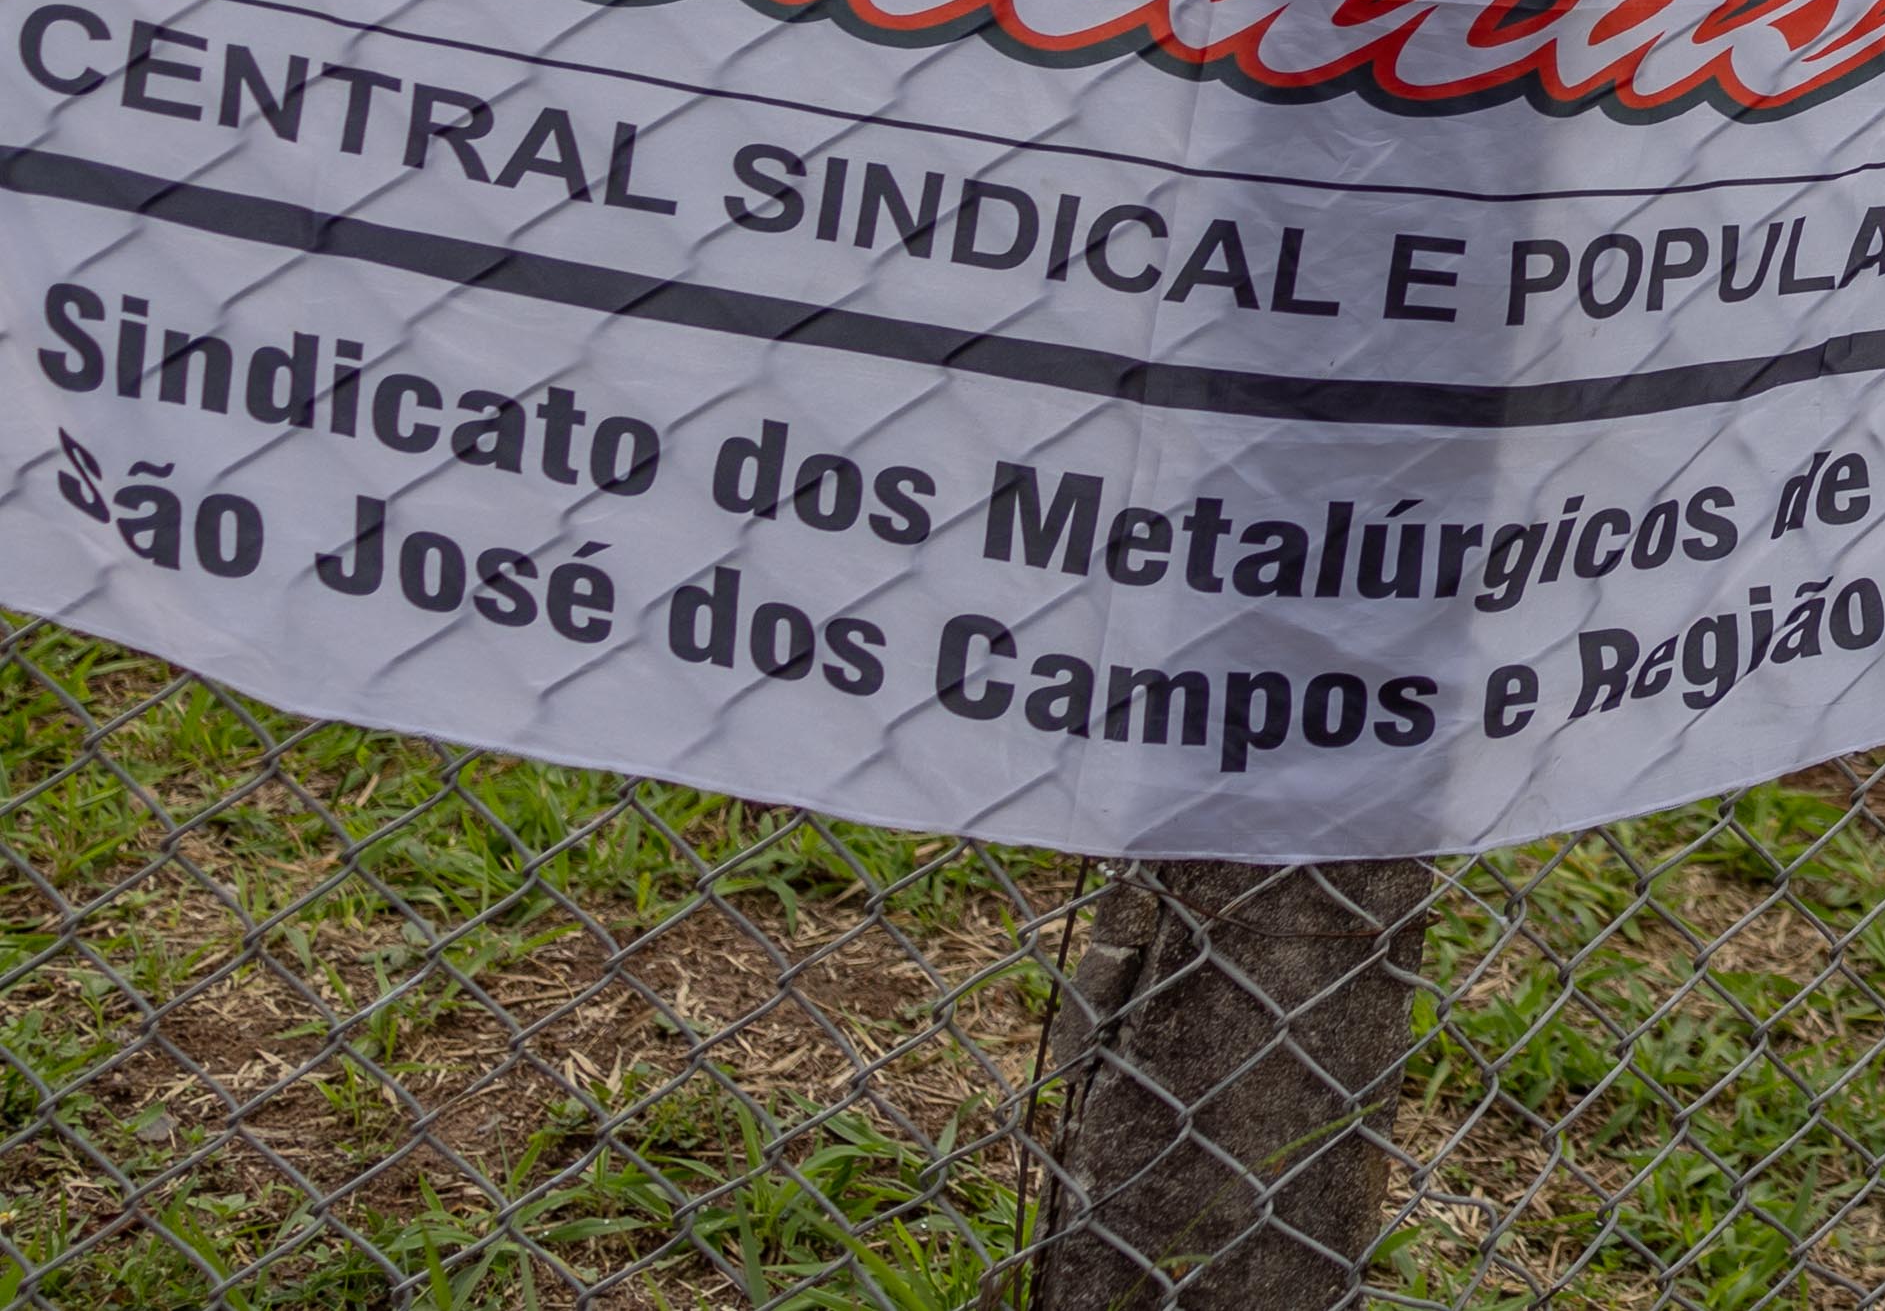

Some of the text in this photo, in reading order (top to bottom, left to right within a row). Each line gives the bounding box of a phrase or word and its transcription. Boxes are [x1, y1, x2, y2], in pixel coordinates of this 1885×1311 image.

[18, 3, 678, 216] CENTRAL
[723, 143, 1340, 317] SINDICAL
[1383, 233, 1467, 323] E
[37, 282, 1871, 613] Sindicato dos Metalúrgicos de
[57, 426, 1885, 773] São José dos Campos e Região
